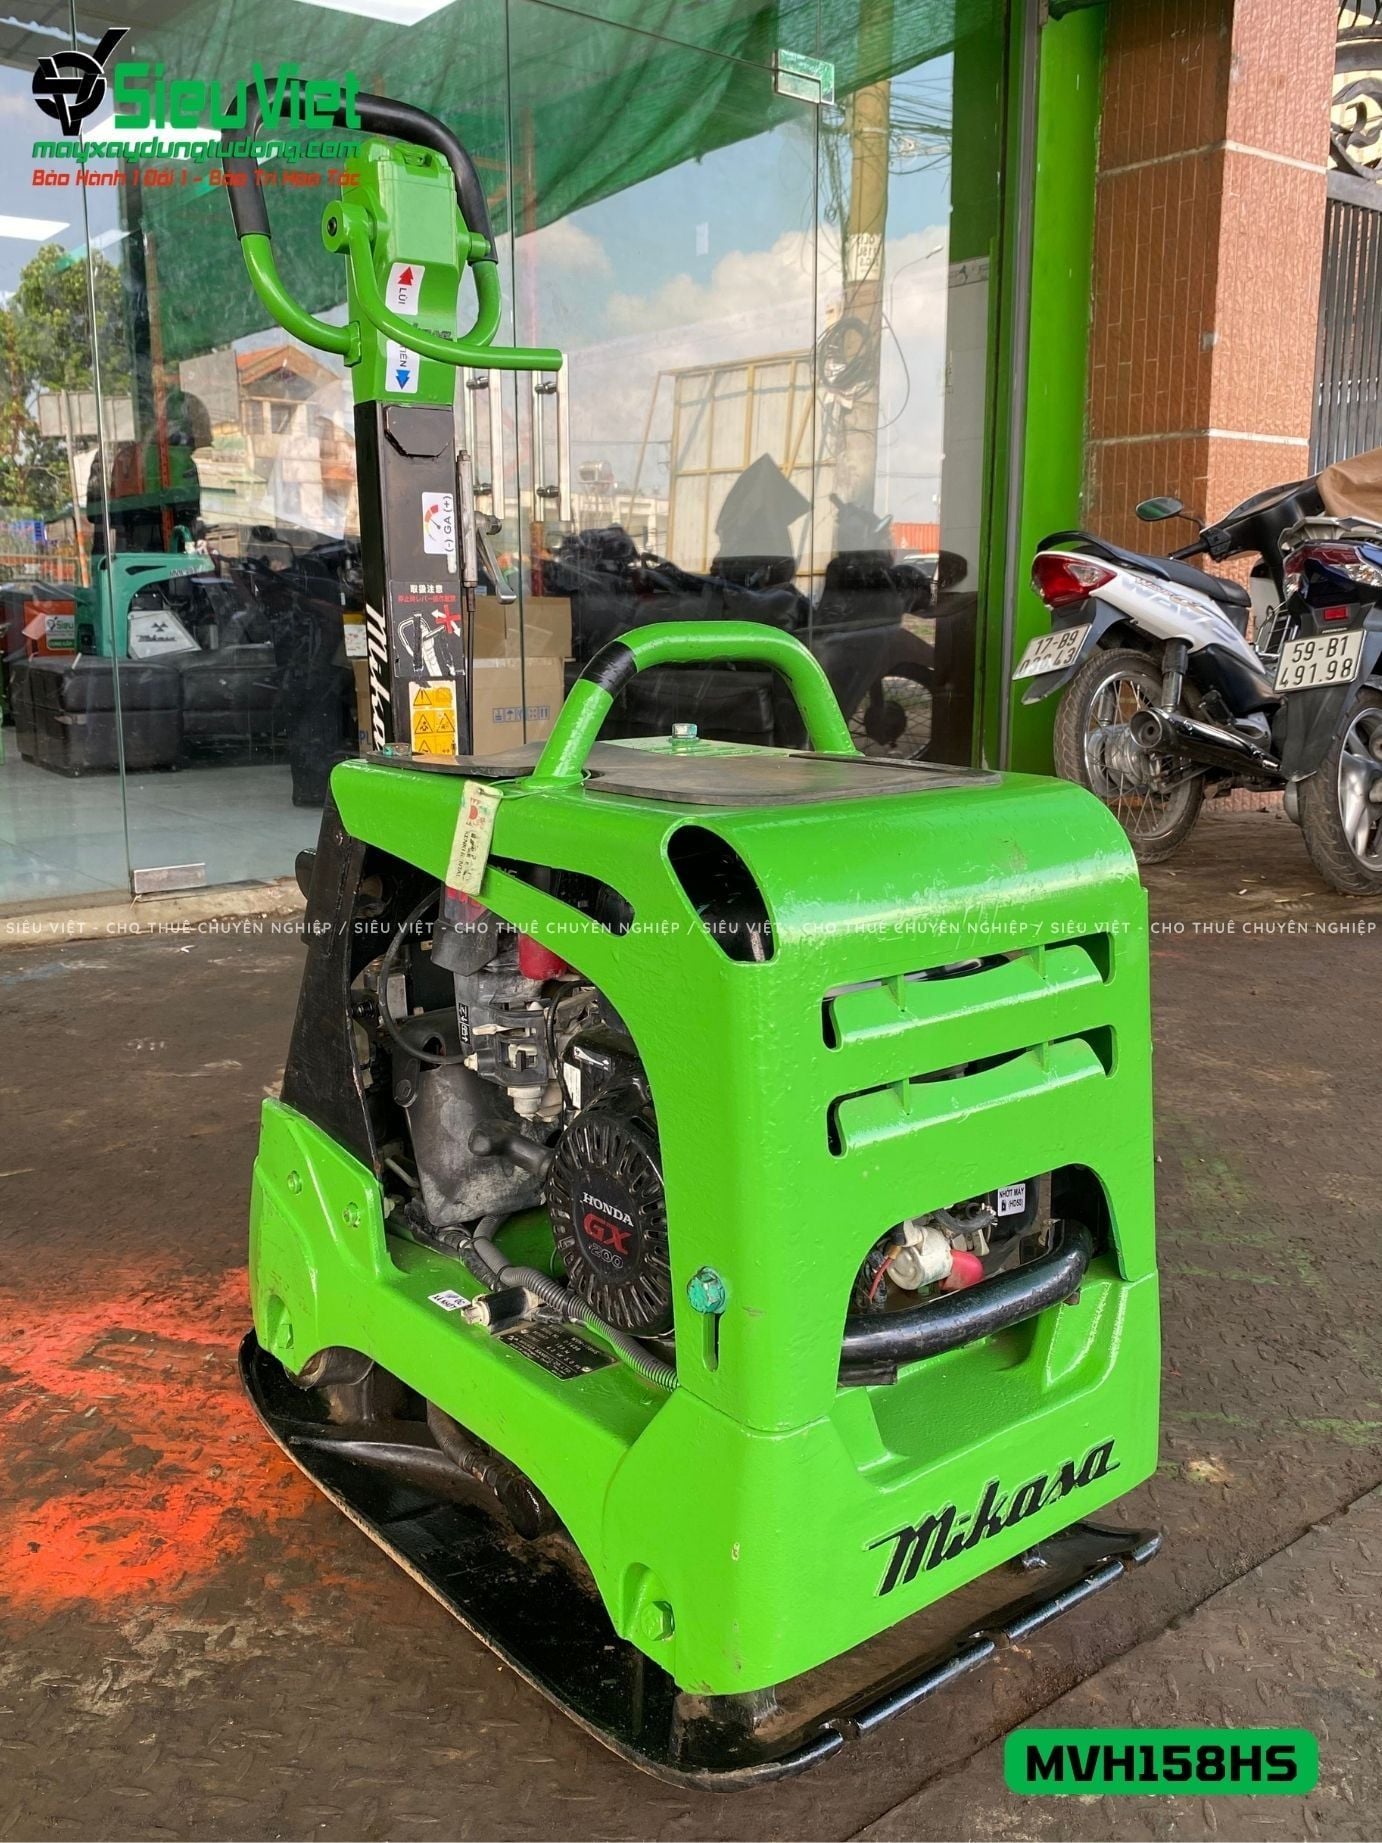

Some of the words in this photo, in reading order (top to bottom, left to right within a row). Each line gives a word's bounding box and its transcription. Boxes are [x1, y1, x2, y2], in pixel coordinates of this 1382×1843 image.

[1034, 629, 1080, 656] 17-B9
[1291, 635, 1349, 663] 59-B1
[1279, 658, 1353, 688] 491.98
[580, 1191, 635, 1228] HONDA
[583, 1212, 633, 1256] GX
[589, 1242, 624, 1269] 200
[868, 1437, 1121, 1597] Mikasa
